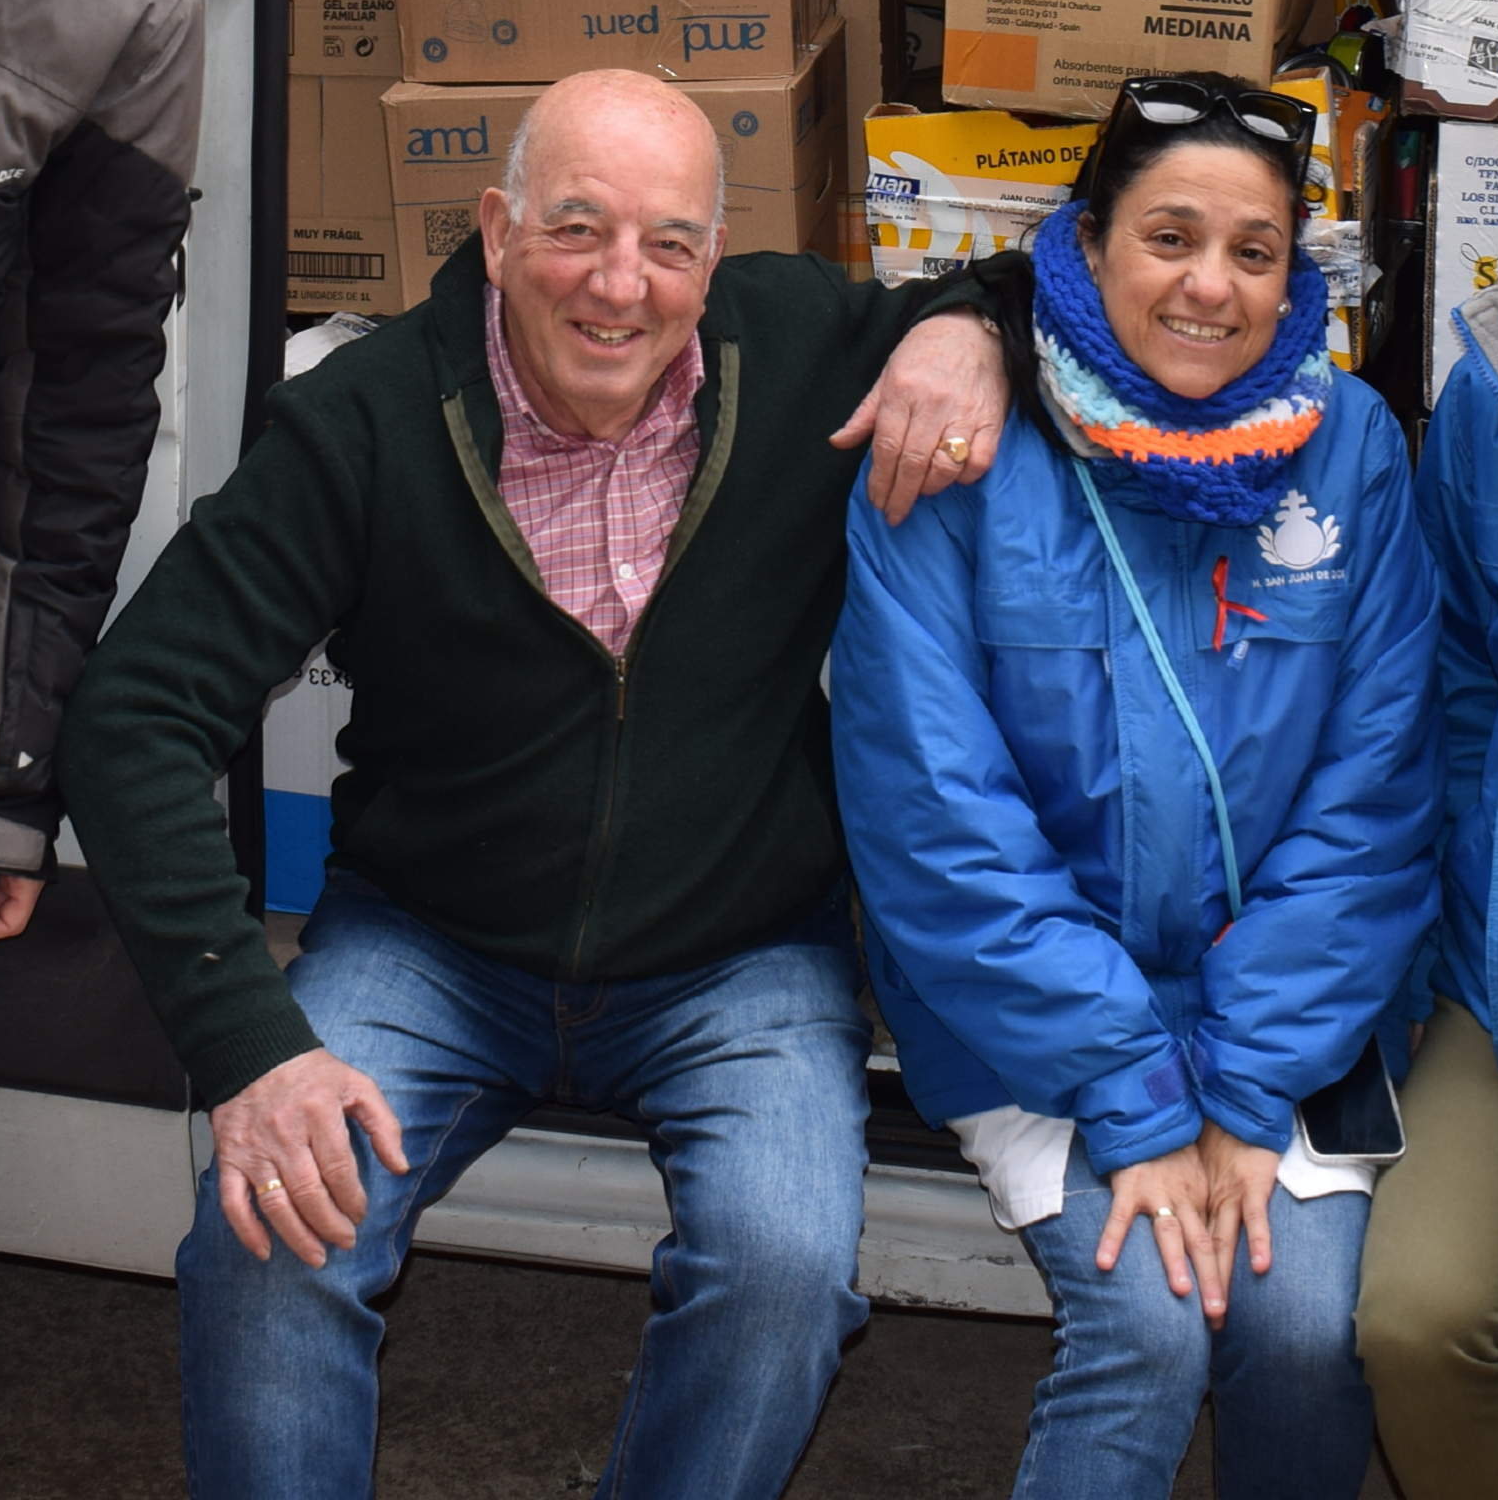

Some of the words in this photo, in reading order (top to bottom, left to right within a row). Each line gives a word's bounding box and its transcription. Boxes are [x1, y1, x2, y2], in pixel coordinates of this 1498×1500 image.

[323, 0, 345, 10] GEL
[348, 2, 359, 10] DE
[323, 11, 376, 20] FAMILIAR
[581, 5, 659, 39] pant
[1016, 20, 1053, 29] Calatayud
[1059, 23, 1080, 31] Spain
[1473, 16, 1495, 28] JUAN
[1144, 16, 1252, 42] MEDIANA
[683, 22, 766, 63] amd
[1054, 59, 1123, 74] Absorbentes
[1126, 66, 1150, 79] para
[1053, 75, 1081, 87] orina
[408, 115, 489, 155] amd
[976, 149, 1055, 169] PLÁTANO
[1061, 146, 1084, 162] DE
[1000, 193, 1022, 201] JUAN
[1024, 196, 1057, 205] CIUDAD
[1461, 193, 1485, 202] LOS
[294, 229, 319, 239] MUY
[323, 228, 363, 240] FRÁGIL
[287, 290, 298, 298] 12
[301, 290, 345, 300] UNIDADES
[346, 293, 357, 301] DE
[361, 293, 370, 301] 1L
[1266, 576, 1285, 587] SAN
[1289, 572, 1313, 583] JUAN
[1316, 570, 1329, 579] DE
